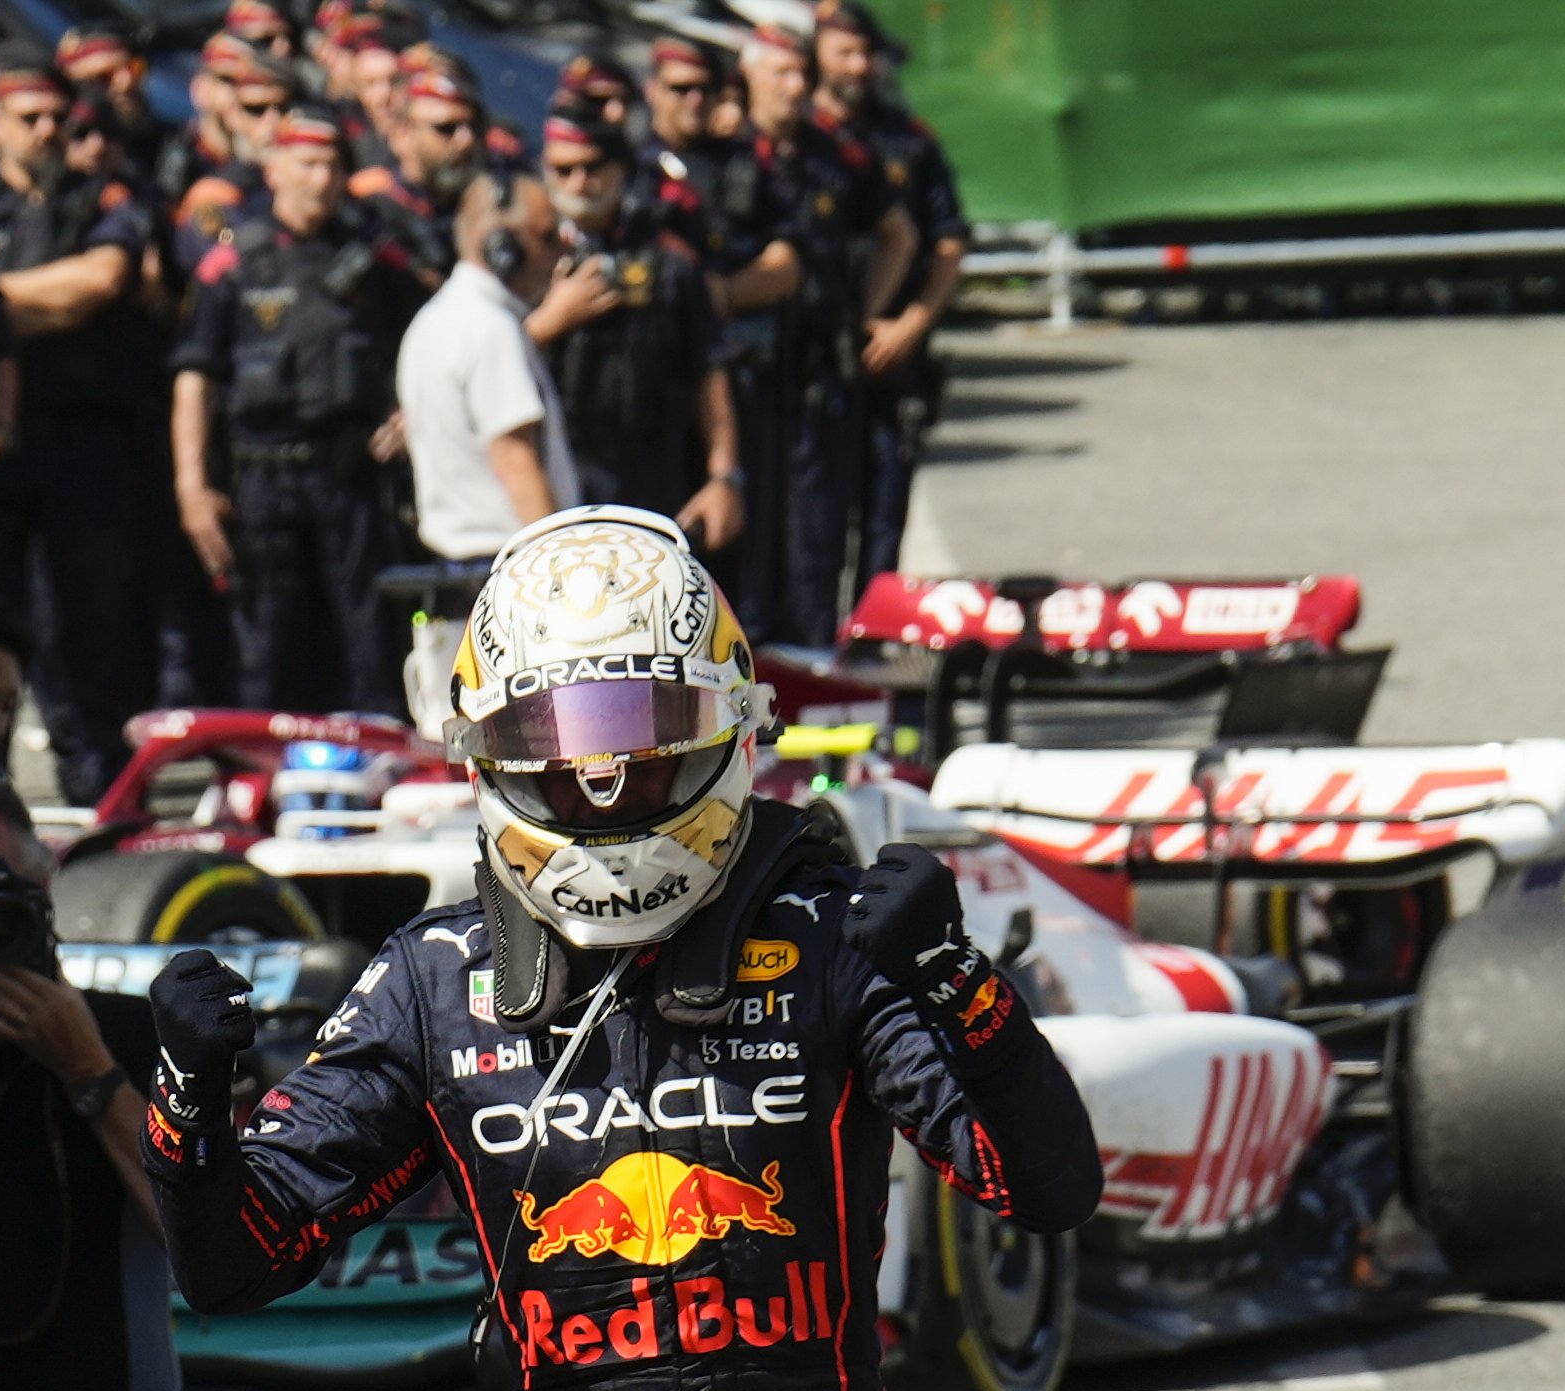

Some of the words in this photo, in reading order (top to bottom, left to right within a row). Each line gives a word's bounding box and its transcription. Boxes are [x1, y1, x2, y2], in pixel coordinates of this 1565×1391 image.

[510, 654, 678, 698] ORACLE
[551, 872, 690, 918] CarNext
[738, 949, 787, 970] AUCH
[450, 1039, 534, 1079] Mobil
[726, 1038, 800, 1060] Tezos
[471, 1074, 809, 1154] ORACLE
[519, 1277, 659, 1368] Red
[674, 1260, 834, 1354] Bull
